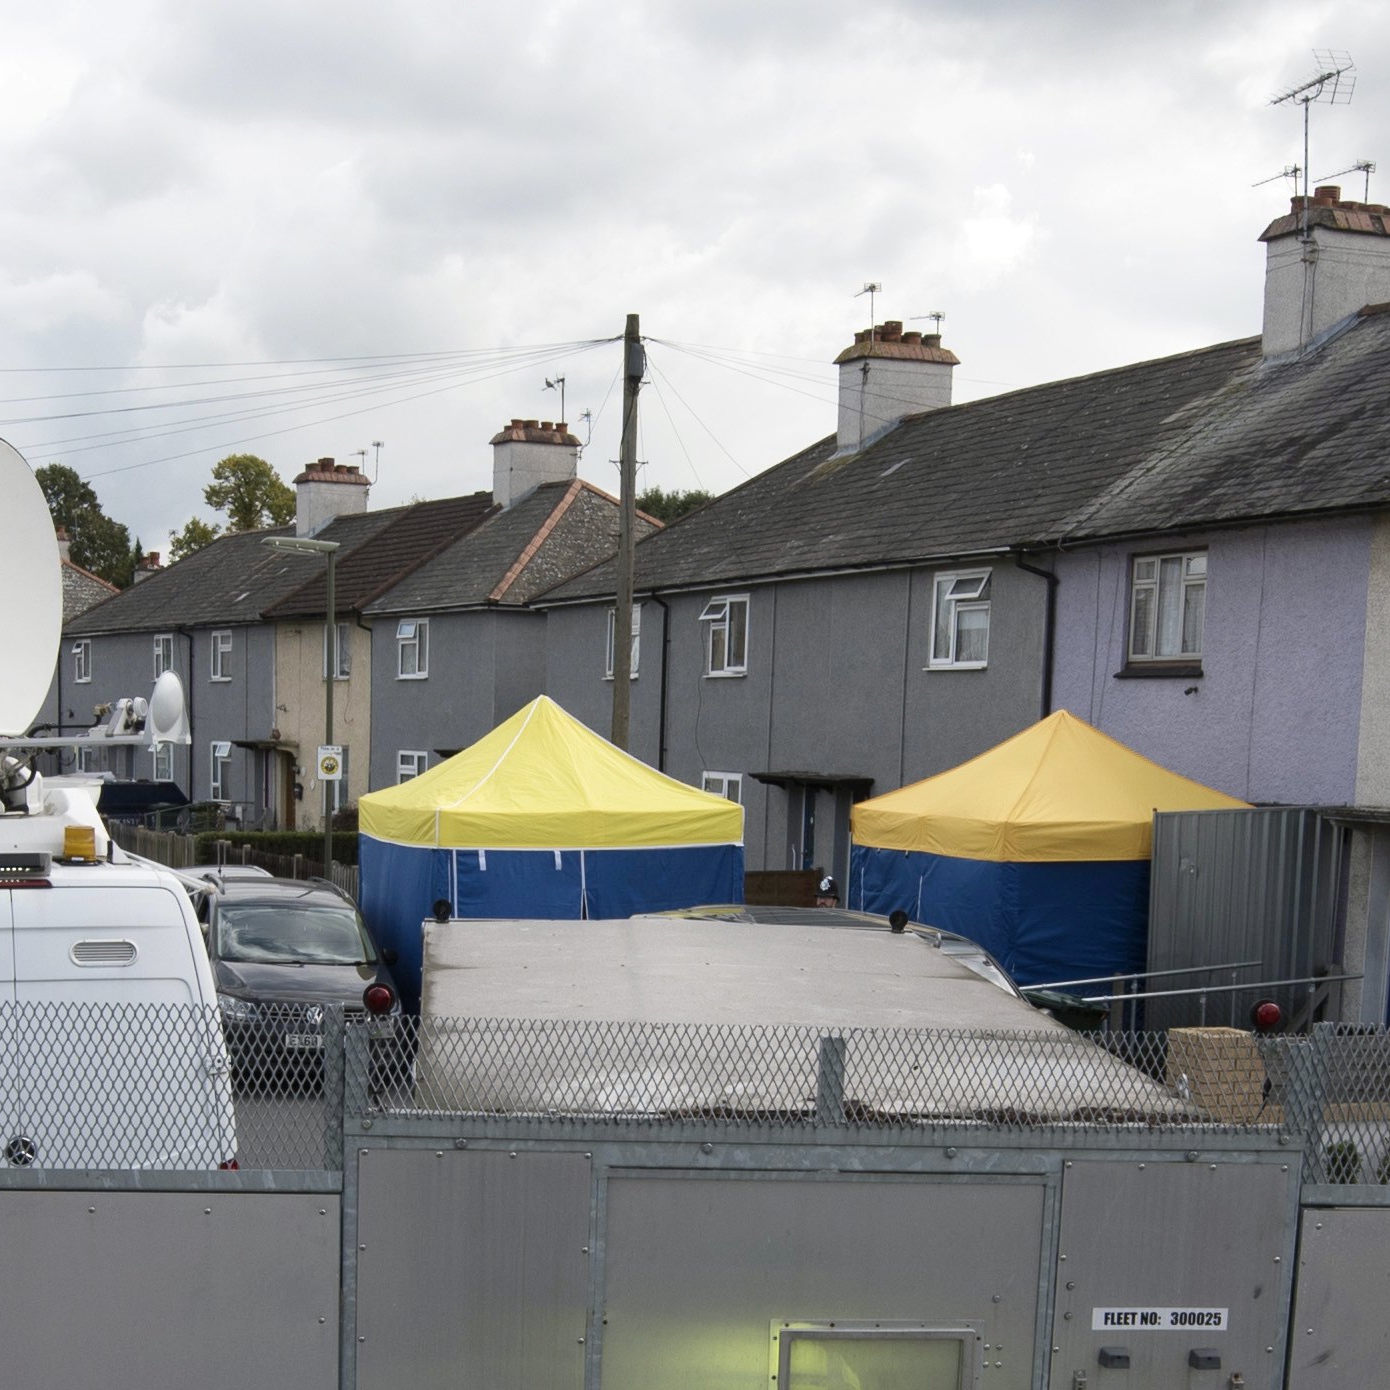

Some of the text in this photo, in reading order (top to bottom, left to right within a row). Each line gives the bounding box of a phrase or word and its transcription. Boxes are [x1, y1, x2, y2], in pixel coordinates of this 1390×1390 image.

[1103, 1311, 1222, 1327] FLEET NO: 300025
